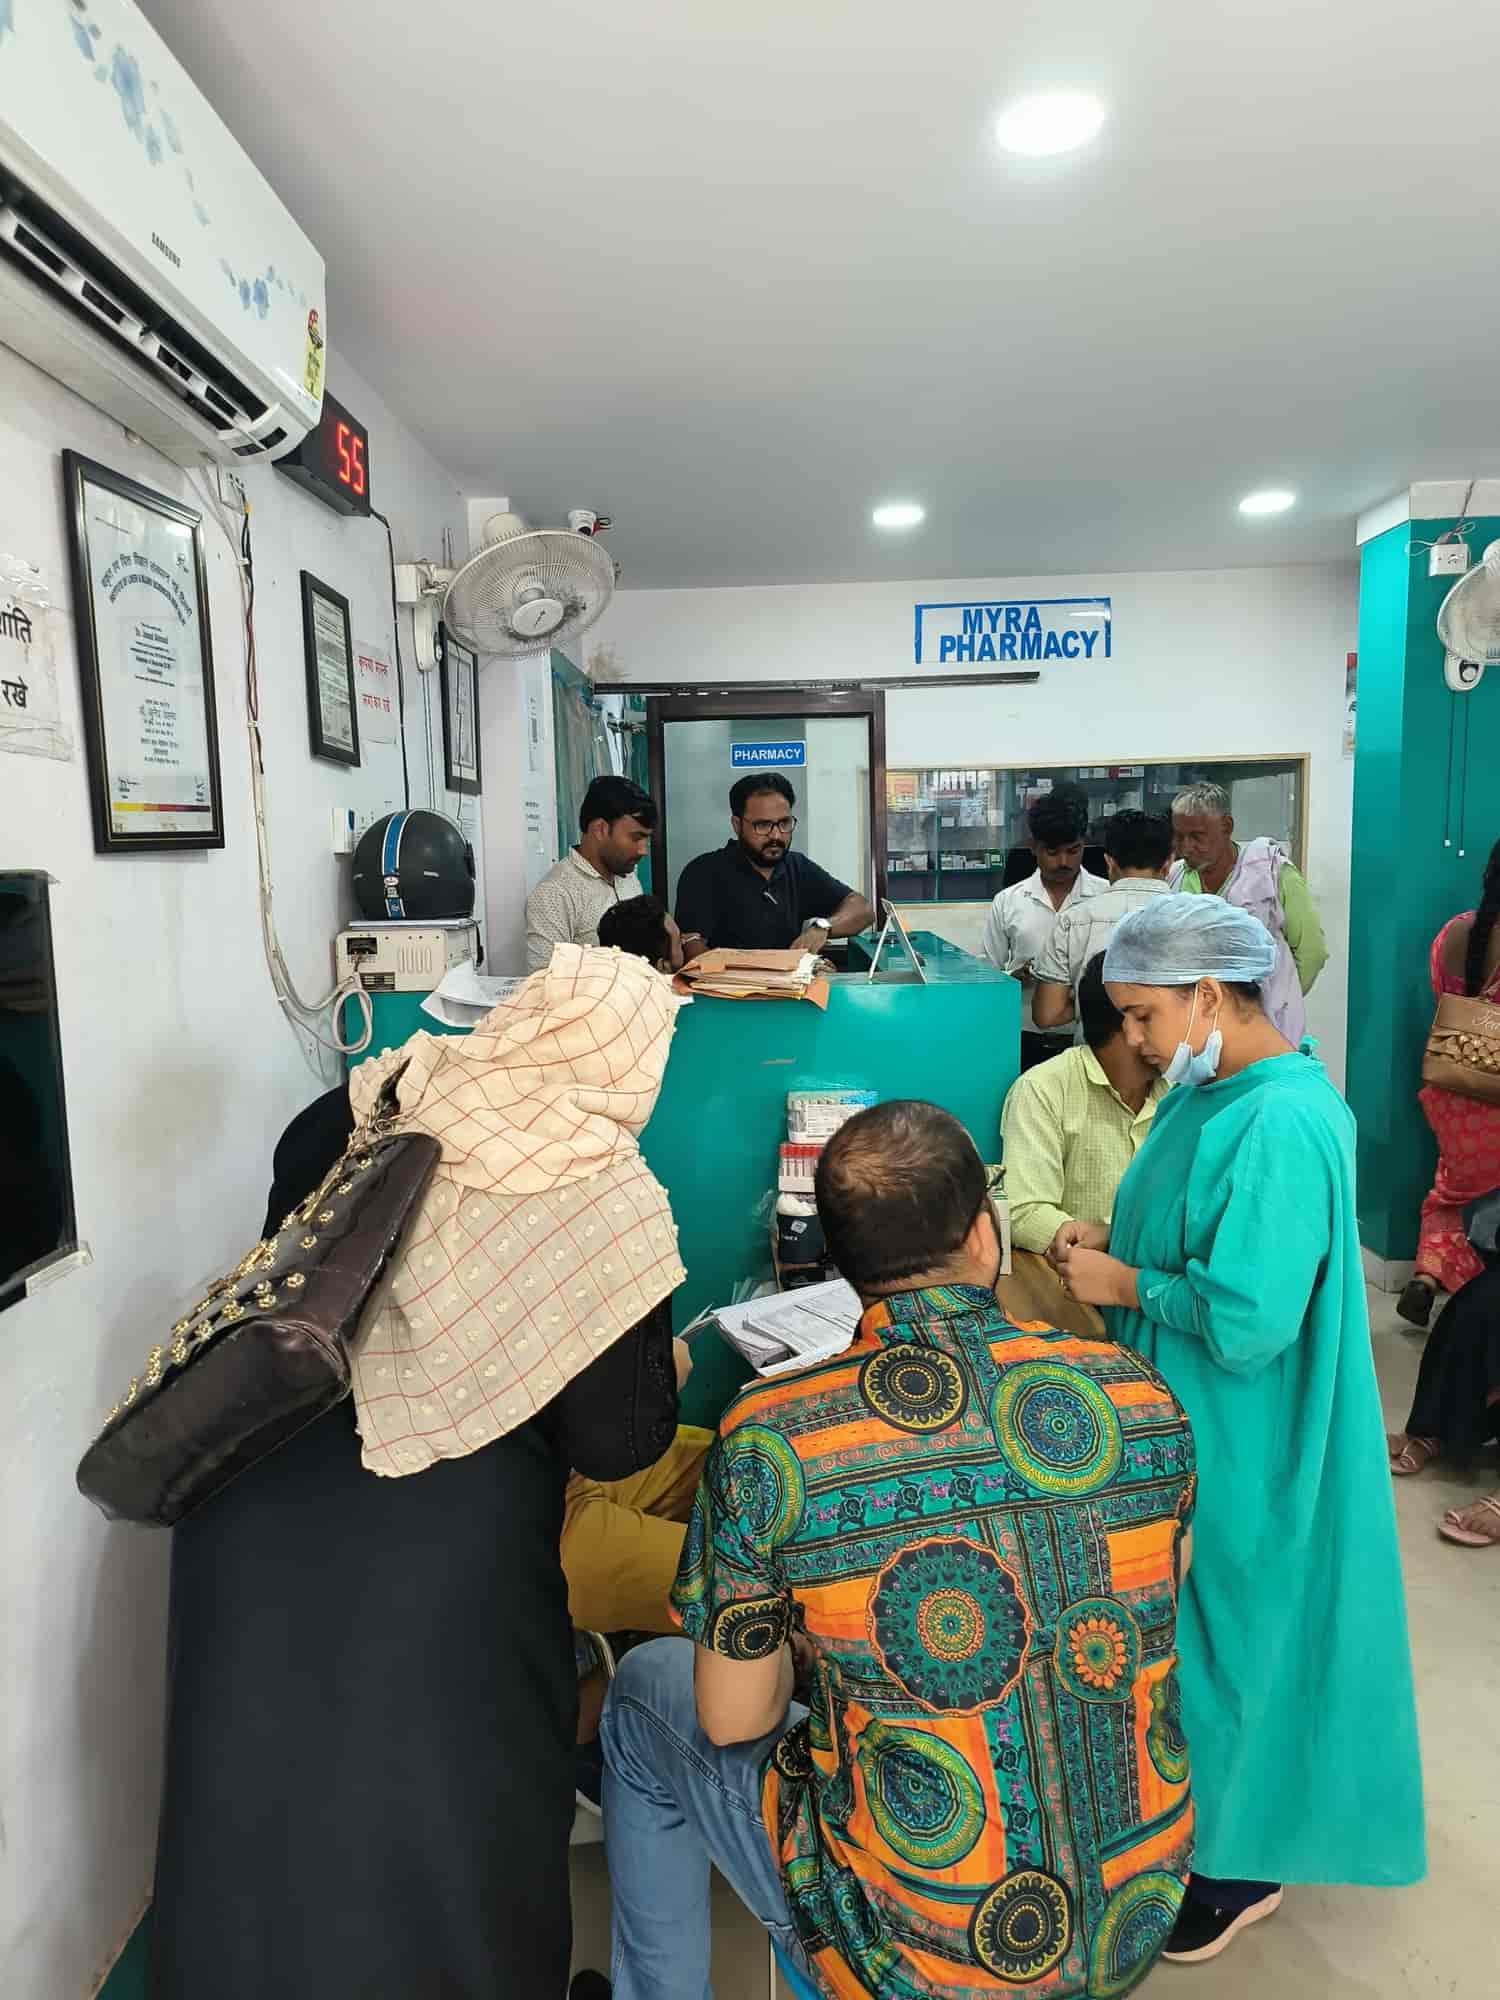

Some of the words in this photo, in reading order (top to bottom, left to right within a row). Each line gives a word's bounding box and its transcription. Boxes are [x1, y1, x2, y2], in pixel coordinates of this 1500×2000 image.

[336, 422, 365, 496] 55
[963, 606, 1042, 634] MYRA
[939, 630, 1099, 663] PHARMACY
[734, 748, 801, 761] PHARMACY
